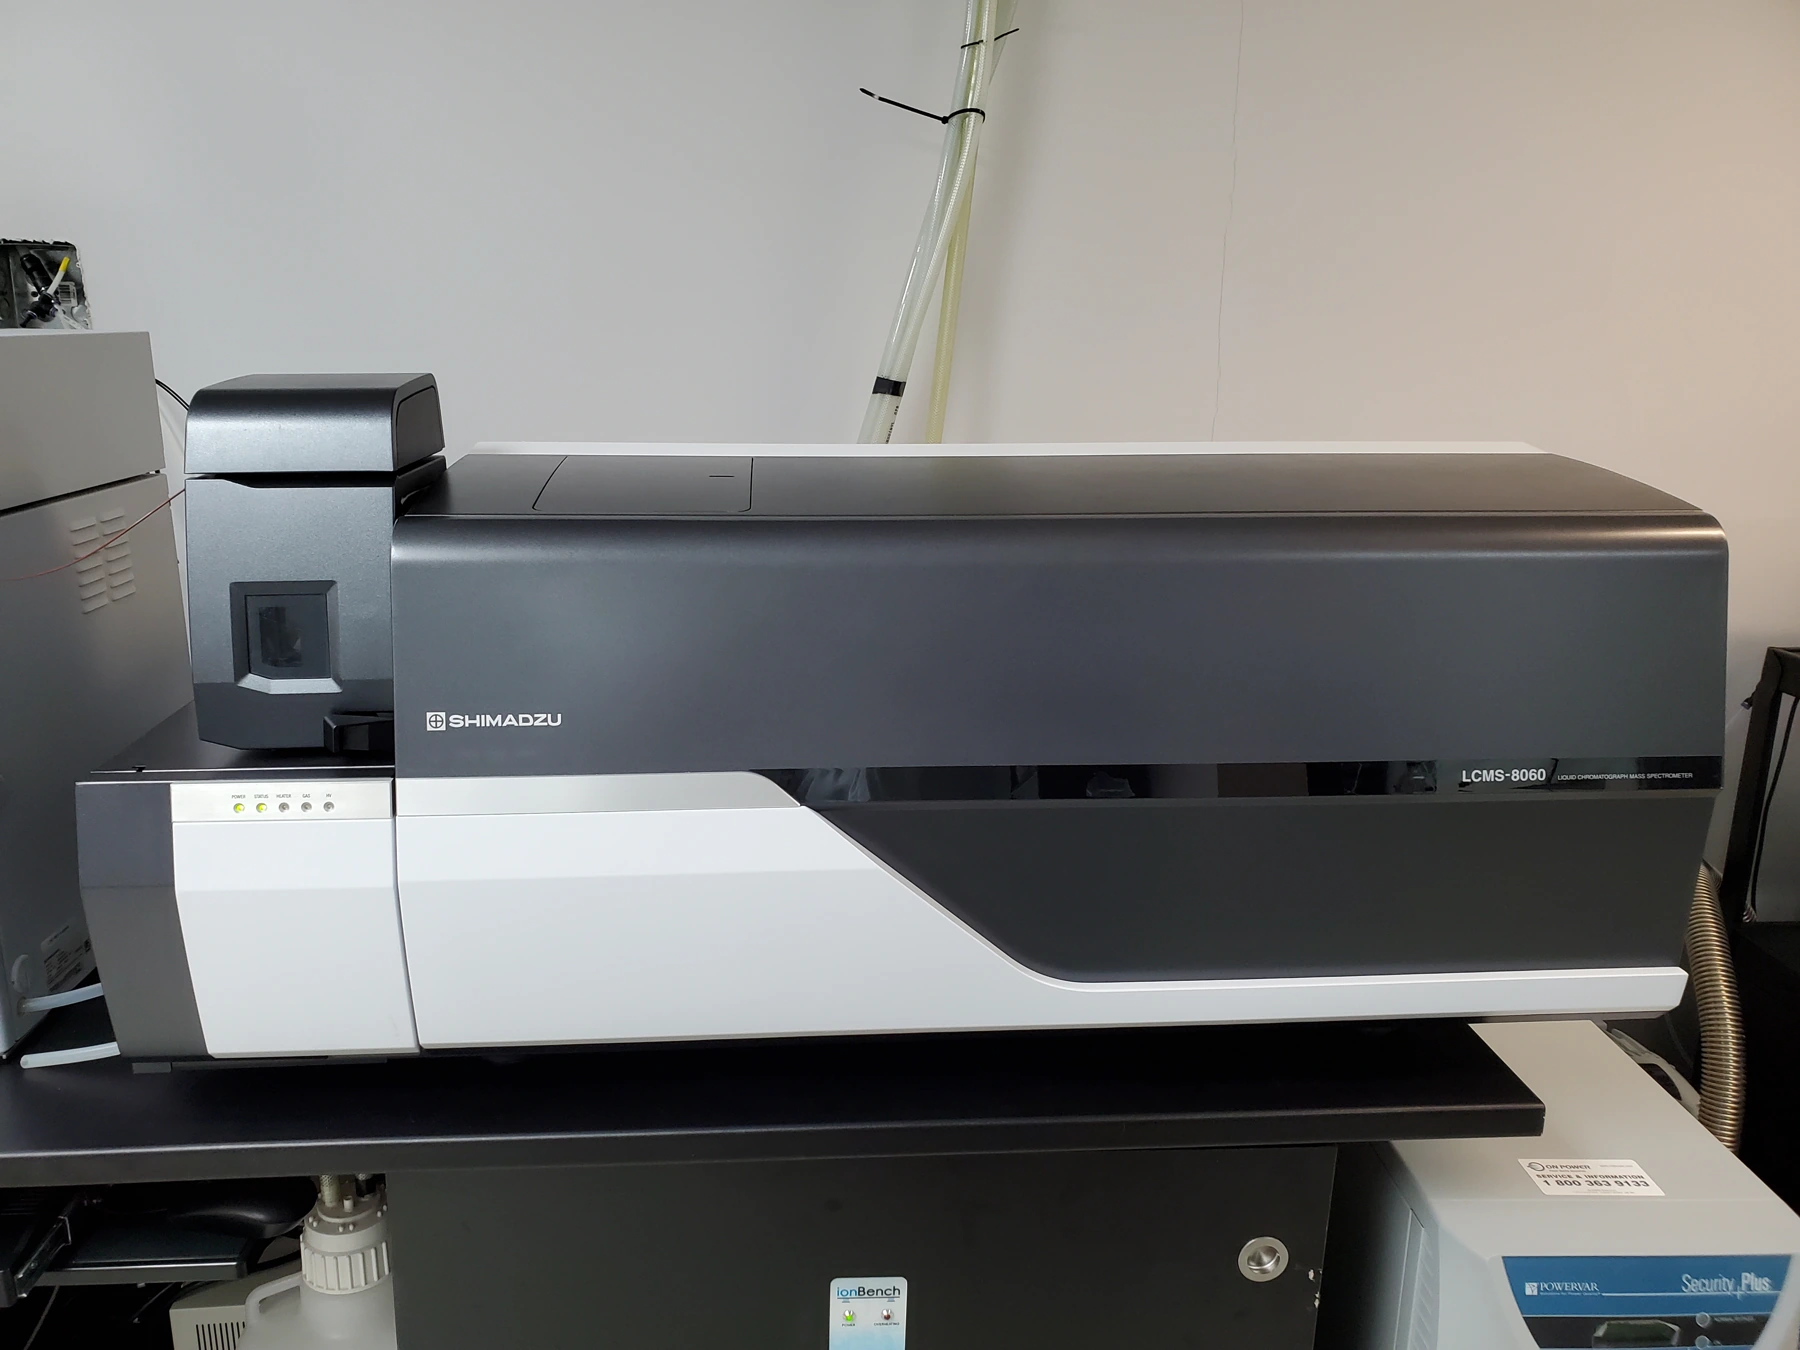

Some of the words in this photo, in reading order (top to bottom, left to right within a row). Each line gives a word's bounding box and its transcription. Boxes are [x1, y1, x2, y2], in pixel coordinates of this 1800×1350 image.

[448, 713, 562, 728] SHIMADZU
[1462, 768, 1546, 782] LCMS-8060
[1540, 1282, 1600, 1292] POWERVAR
[1681, 1273, 1735, 1296] Security
[1741, 1271, 1772, 1291] Plus
[837, 1285, 901, 1297] ionBench
